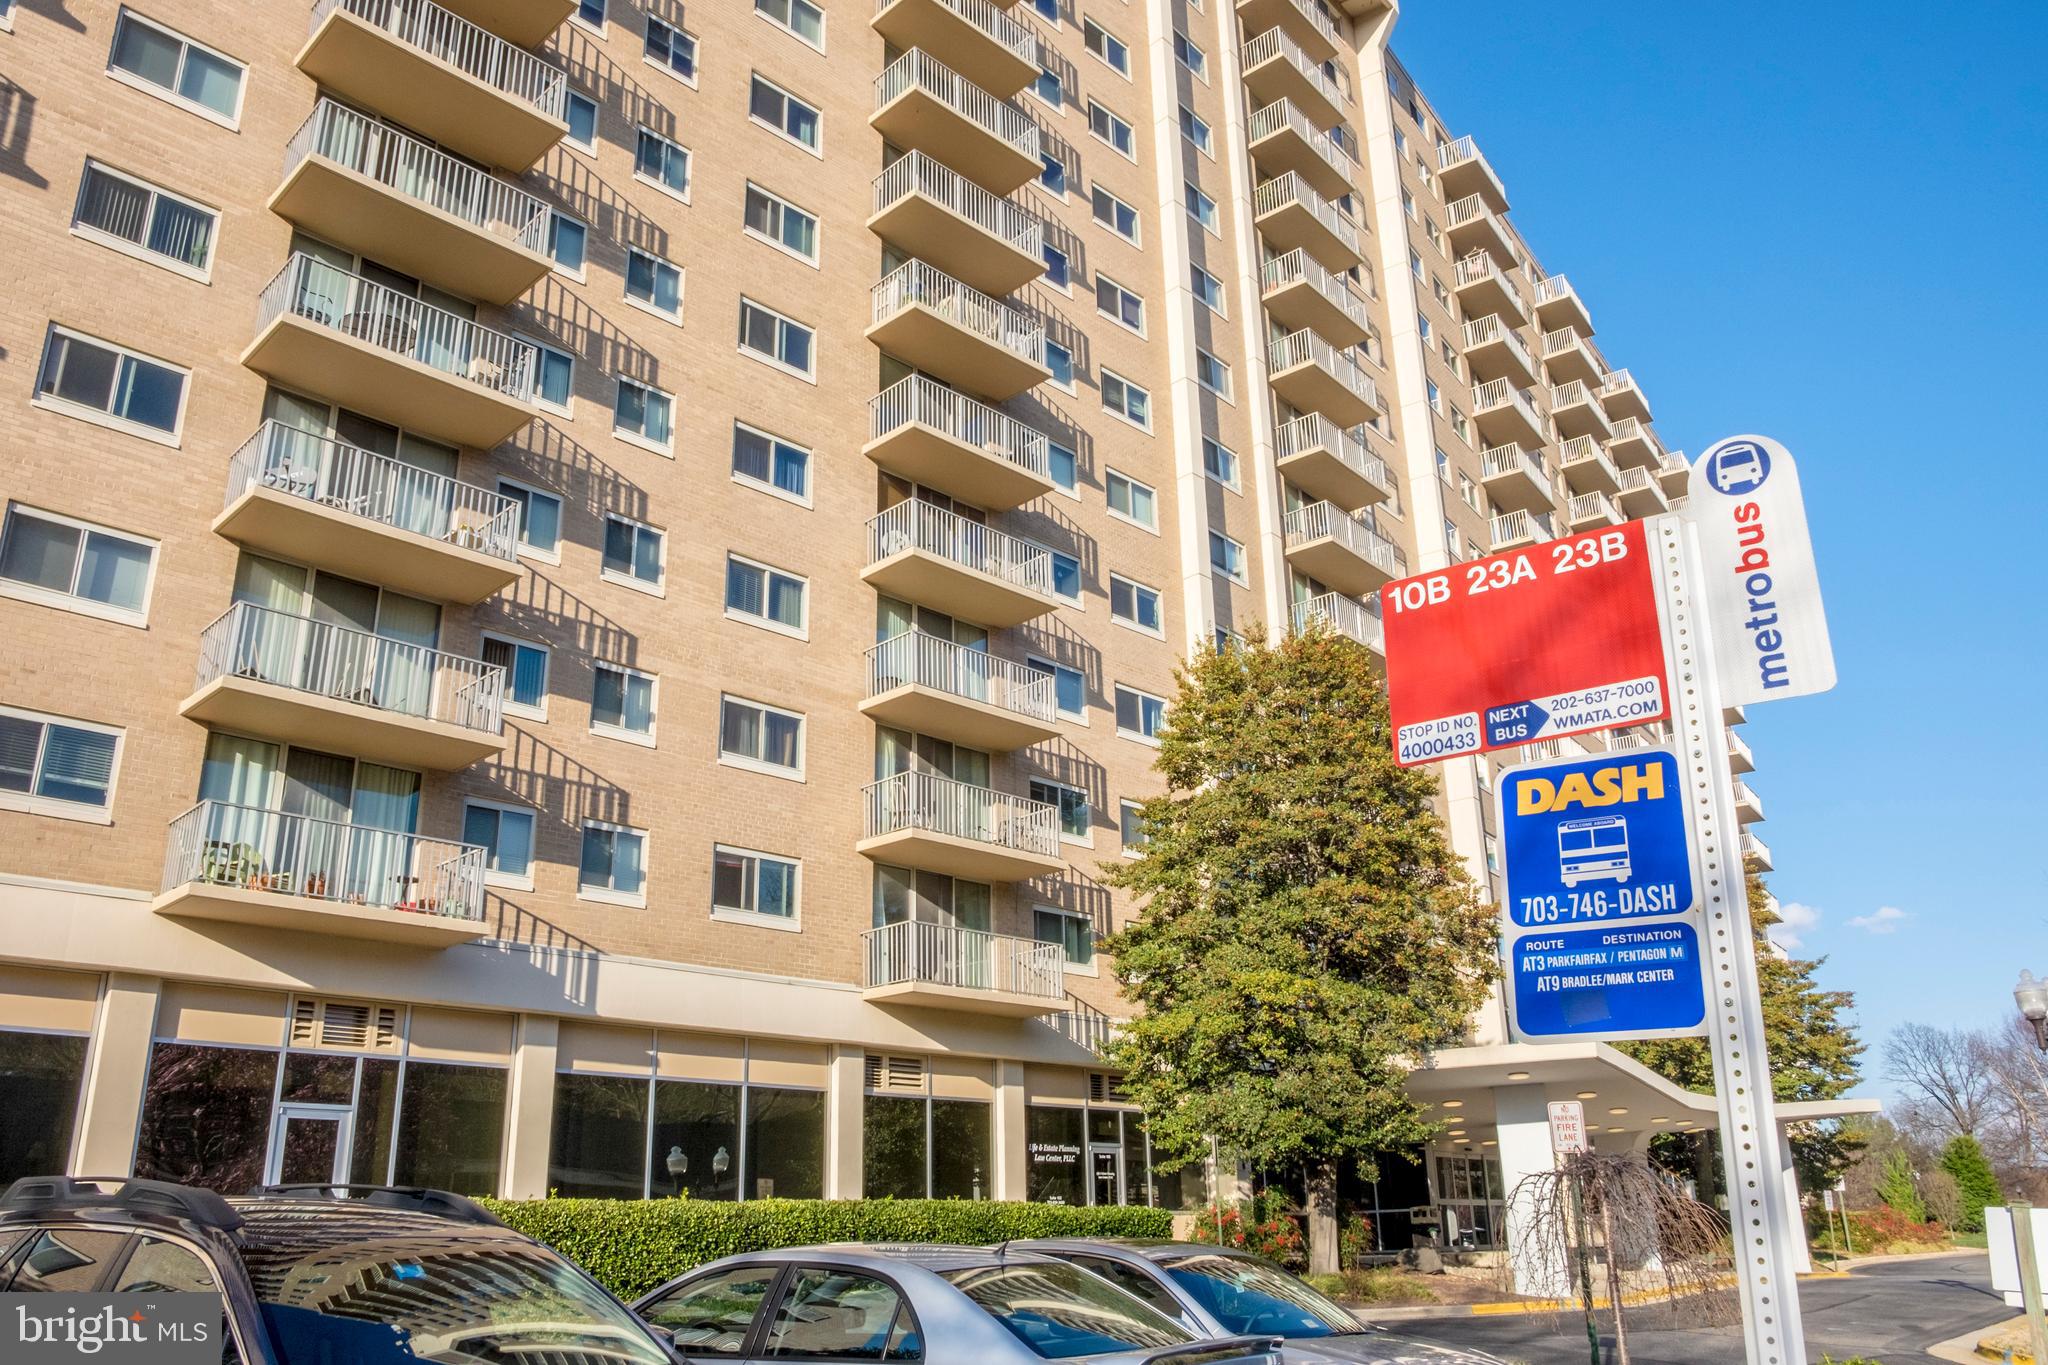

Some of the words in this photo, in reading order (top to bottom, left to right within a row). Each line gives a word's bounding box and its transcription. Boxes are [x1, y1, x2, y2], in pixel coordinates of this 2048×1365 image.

[1388, 575, 1451, 613] 10B
[1466, 556, 1537, 596] 23A
[1552, 532, 1628, 575] 23B
[1734, 501, 1790, 690] metrobus
[1551, 681, 1655, 712] 202-637-7000
[1489, 704, 1529, 724] NEXT
[1553, 699, 1658, 729] WMATA.COM
[1399, 723, 1433, 741] STOP
[1436, 720, 1449, 733] ID
[1453, 716, 1477, 731] NO.
[1495, 725, 1528, 741] BUS
[1401, 732, 1476, 760] 4000433
[1516, 761, 1664, 816] DASH
[1521, 884, 1676, 924] 703-746-DASH
[1526, 940, 1564, 951] ROUTE
[1602, 930, 1682, 945] DESTINATION
[1522, 955, 1545, 972] AT3
[1547, 952, 1608, 968] PARKFAIRFAX
[1618, 948, 1667, 962] PENTAGON
[1537, 975, 1560, 992] AT9
[1562, 971, 1634, 989] BRADLEE/MARK
[1637, 969, 1674, 983] CENTER
[1557, 1123, 1577, 1131] FIRE
[1559, 1133, 1577, 1141] LANE
[1043, 1144, 1058, 1152] Estate
[1059, 1144, 1080, 1154] Planning
[1063, 1155, 1076, 1163] PLLC
